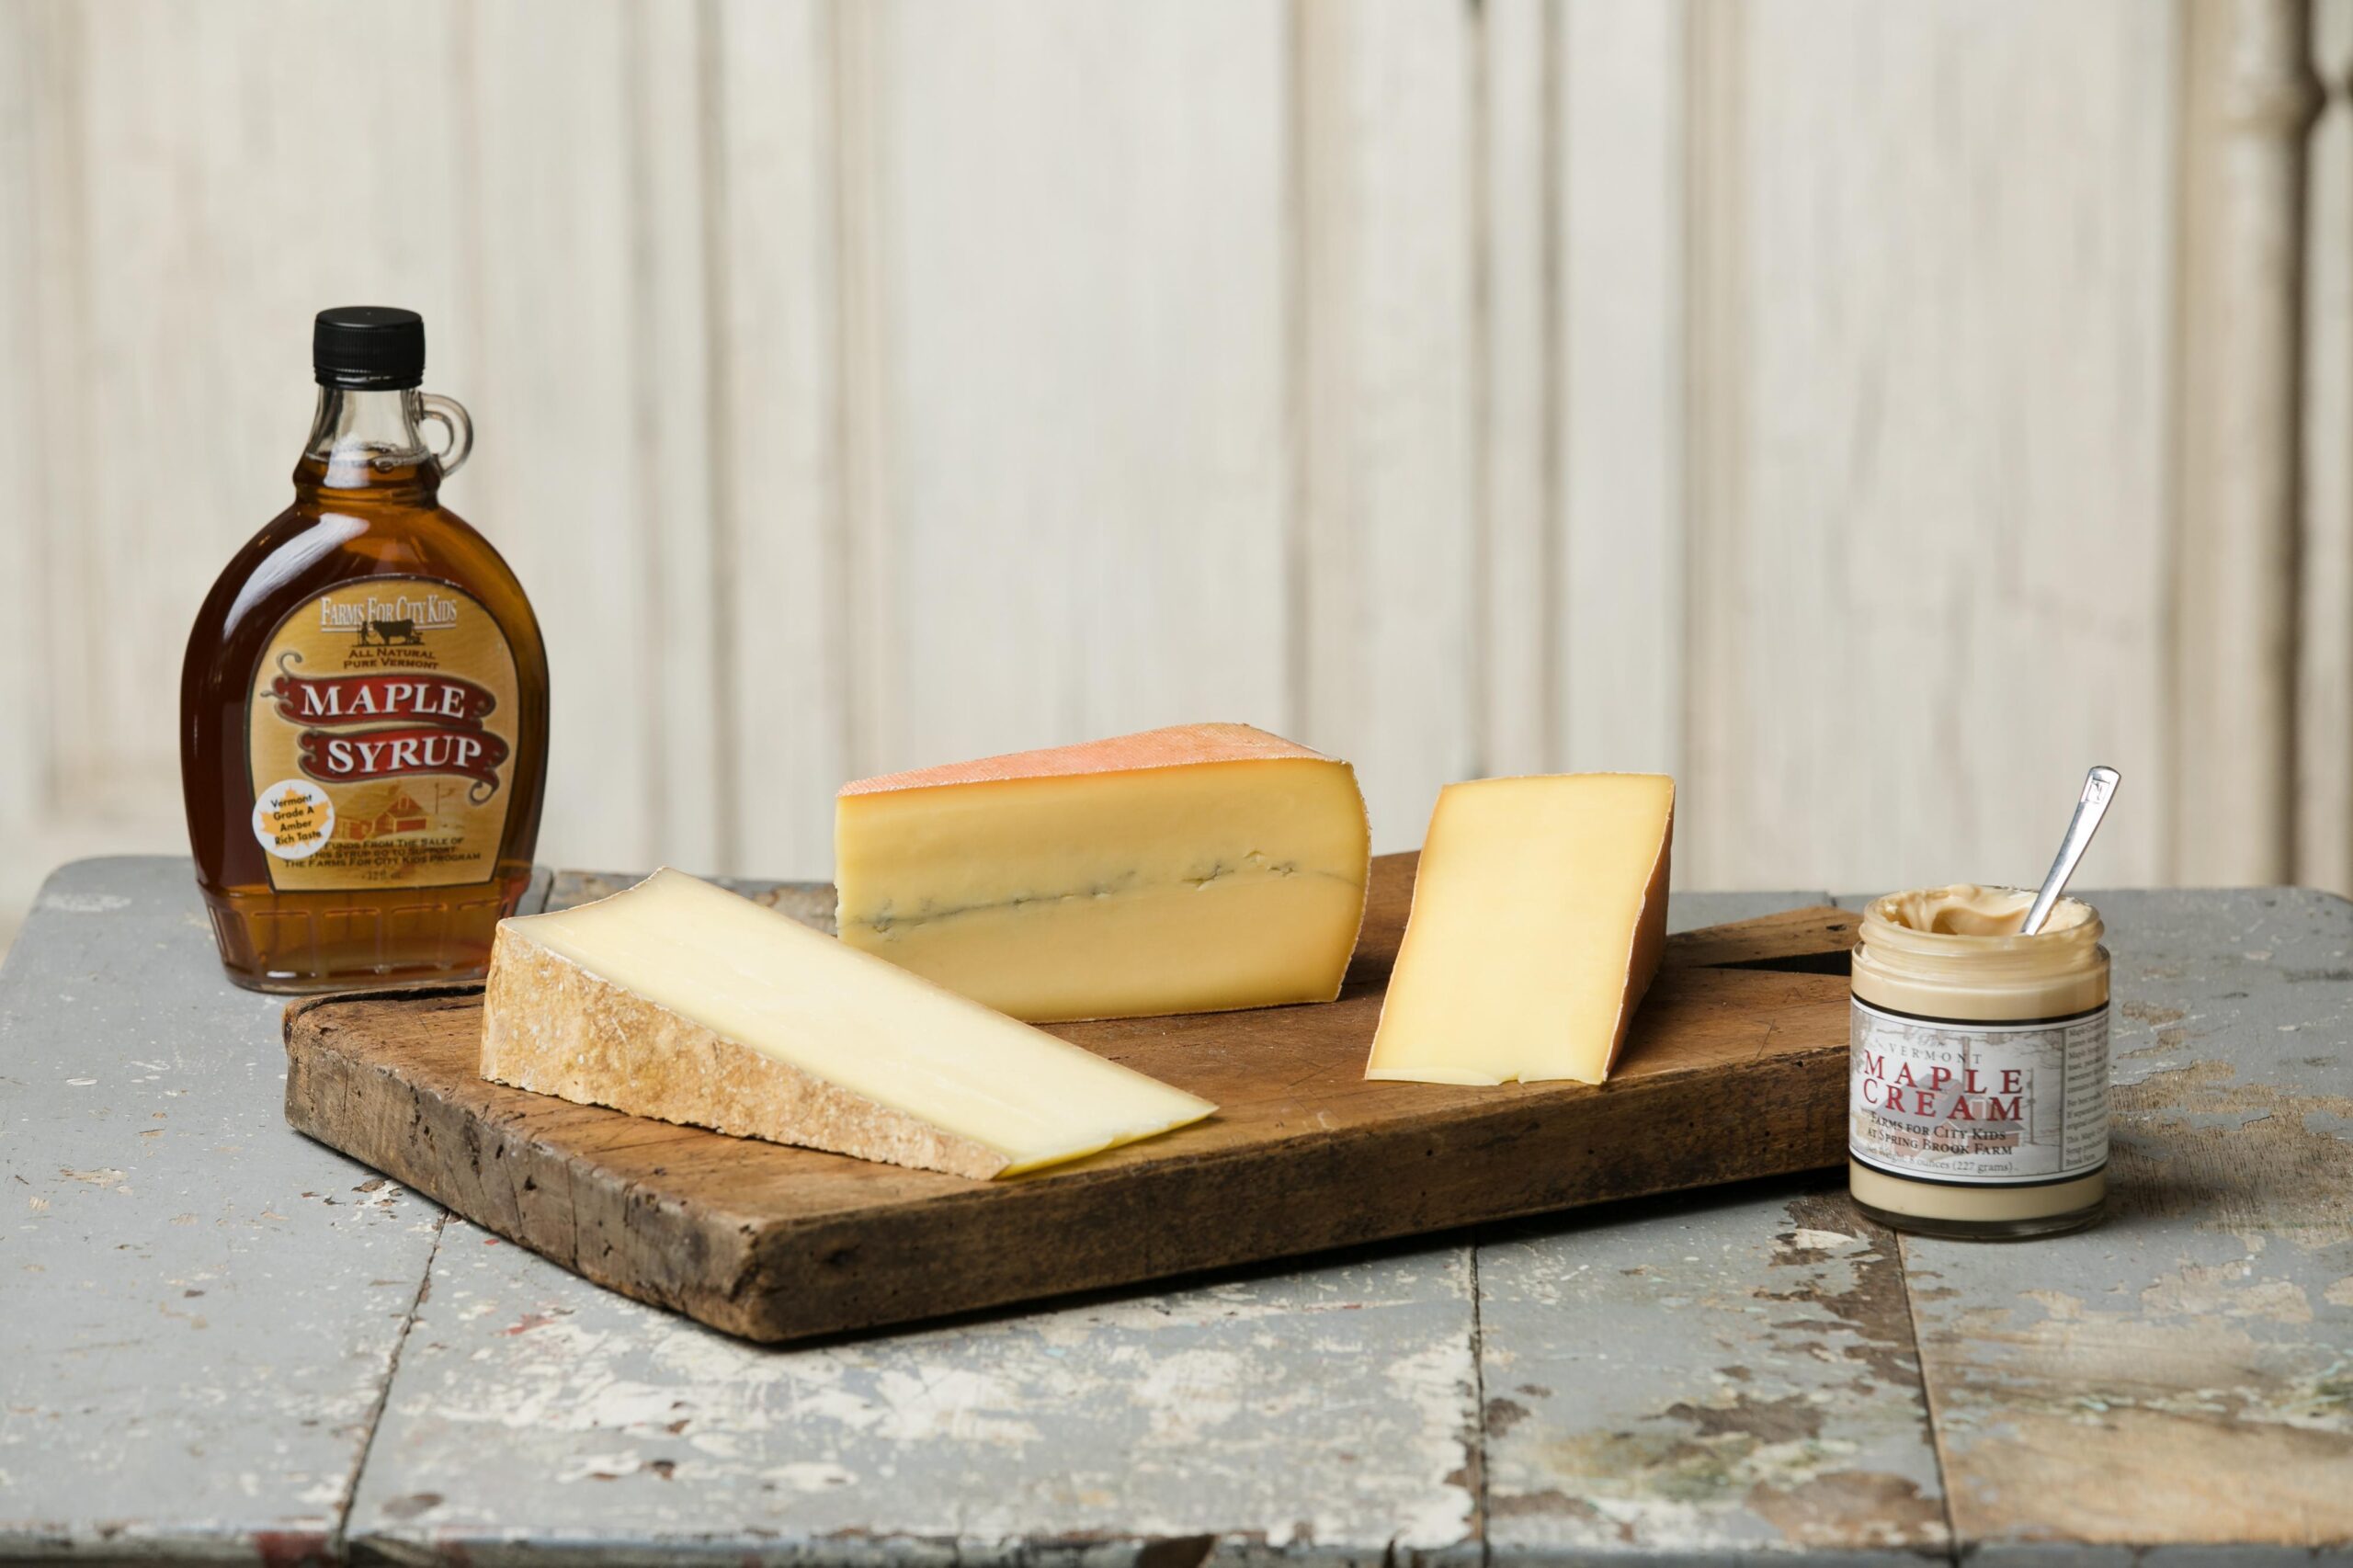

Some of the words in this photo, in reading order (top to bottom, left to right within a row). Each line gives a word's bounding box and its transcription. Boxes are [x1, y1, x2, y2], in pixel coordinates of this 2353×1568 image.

[367, 597, 393, 623] FOR
[396, 596, 426, 624] CITY
[426, 594, 458, 622] KIDS
[348, 649, 373, 659] ALL
[376, 648, 436, 659] NATURAL
[344, 659, 377, 669] PURE
[381, 658, 439, 669] VERMONT
[300, 682, 466, 719] MAPLE
[327, 735, 483, 775] SYRUP
[270, 793, 313, 808] Vermont
[273, 810, 304, 821] Grade
[307, 806, 314, 814] A
[279, 819, 313, 833] Amber
[274, 835, 295, 846] Rich
[297, 830, 322, 841] Taste
[397, 838, 418, 847] THE
[421, 837, 449, 846] SALE
[285, 859, 306, 869] THE
[308, 858, 347, 868] FARMS
[349, 858, 372, 867] FOR
[374, 857, 399, 866] CITY
[429, 853, 482, 863] PROGRAM
[1889, 1042, 1983, 1064] VERMONT
[1863, 1050, 2024, 1095] MAPLE
[1863, 1078, 2024, 1121] CREAM
[1870, 1110, 1904, 1131] FARMS
[1905, 1122, 1929, 1136] FOR
[1933, 1125, 1967, 1140] CITY
[1972, 1127, 2006, 1141] KIDS
[1878, 1130, 1918, 1150] SPRING
[1922, 1138, 1972, 1155] BROOK
[1974, 1142, 2013, 1155] FARM
[1916, 1158, 1950, 1169] ounces
